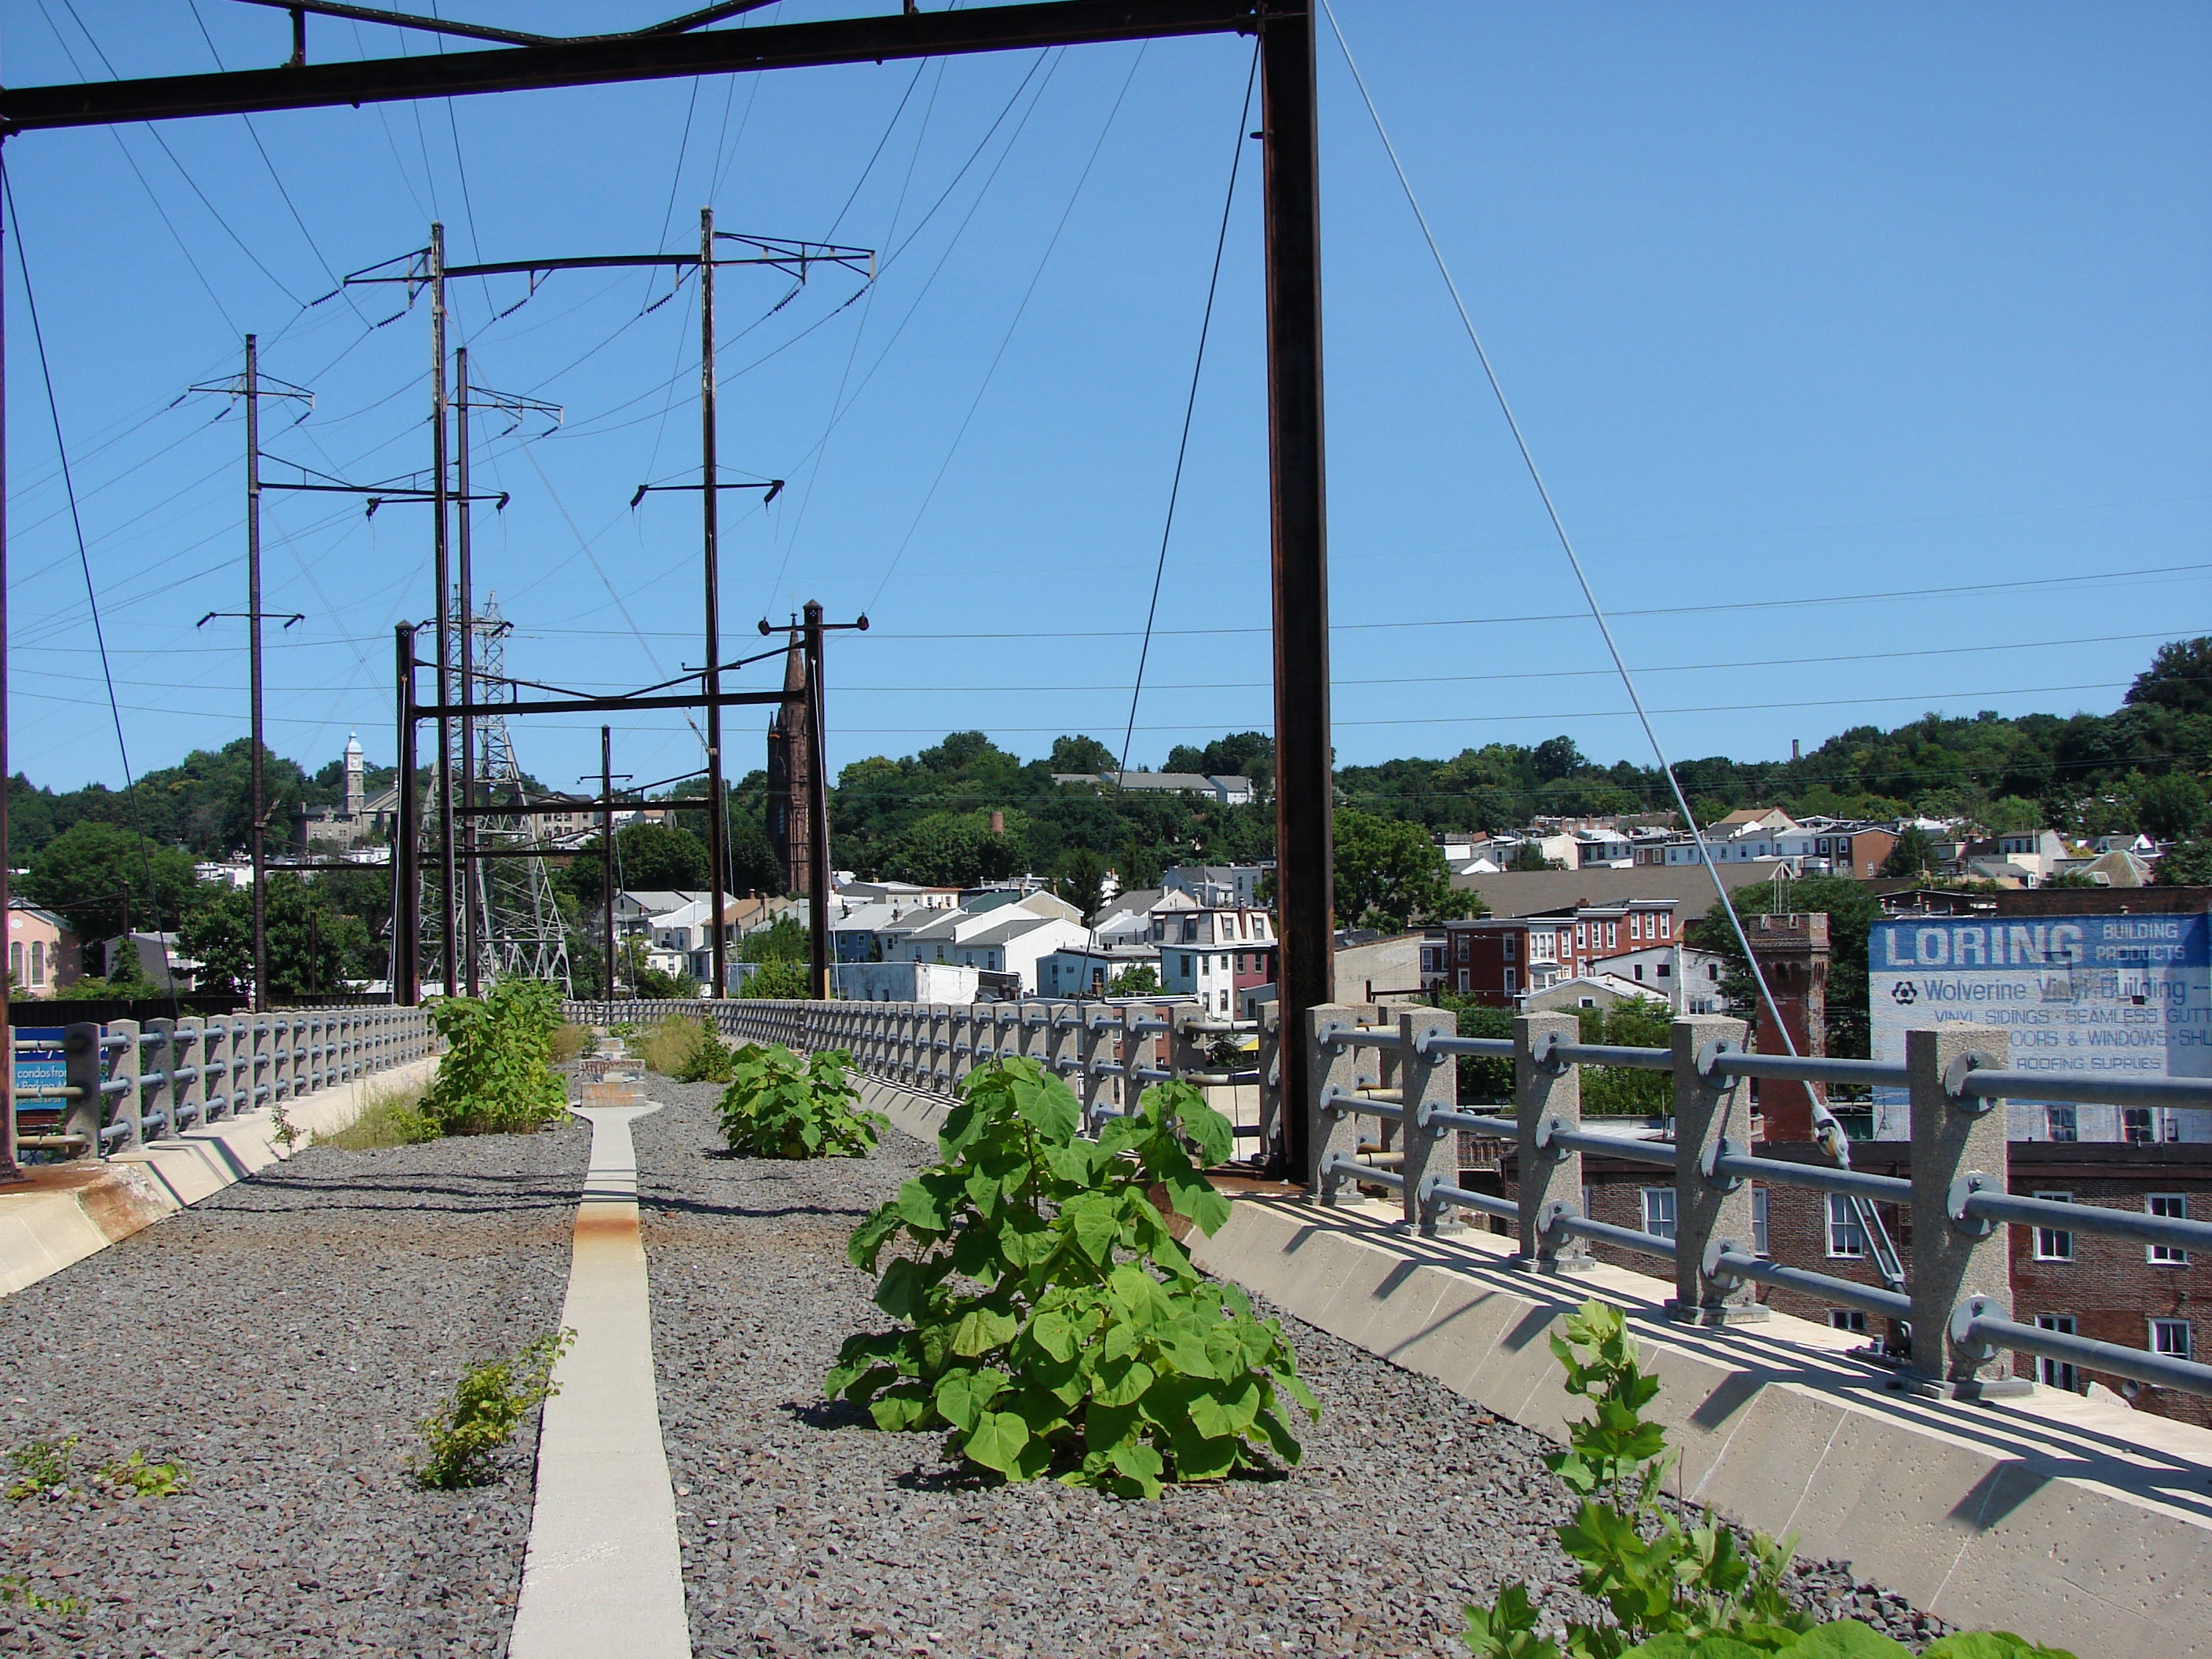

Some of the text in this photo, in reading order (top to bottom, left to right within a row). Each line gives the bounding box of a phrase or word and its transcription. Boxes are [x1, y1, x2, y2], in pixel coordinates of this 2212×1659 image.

[2103, 923, 2177, 939] BUILDING
[1885, 925, 2083, 966] LORING
[2096, 945, 2186, 960] PRODUCTS
[1924, 979, 2026, 1001] Wolverine
[1986, 1009, 2049, 1024] SIDINGS
[2064, 1009, 2158, 1024] SEAMLESS
[2067, 1031, 2078, 1046] &
[2087, 1030, 2167, 1046] WINDOWS
[2016, 1057, 2161, 1070] ROOFING SUPPLIES
[17, 1066, 51, 1079] condos
